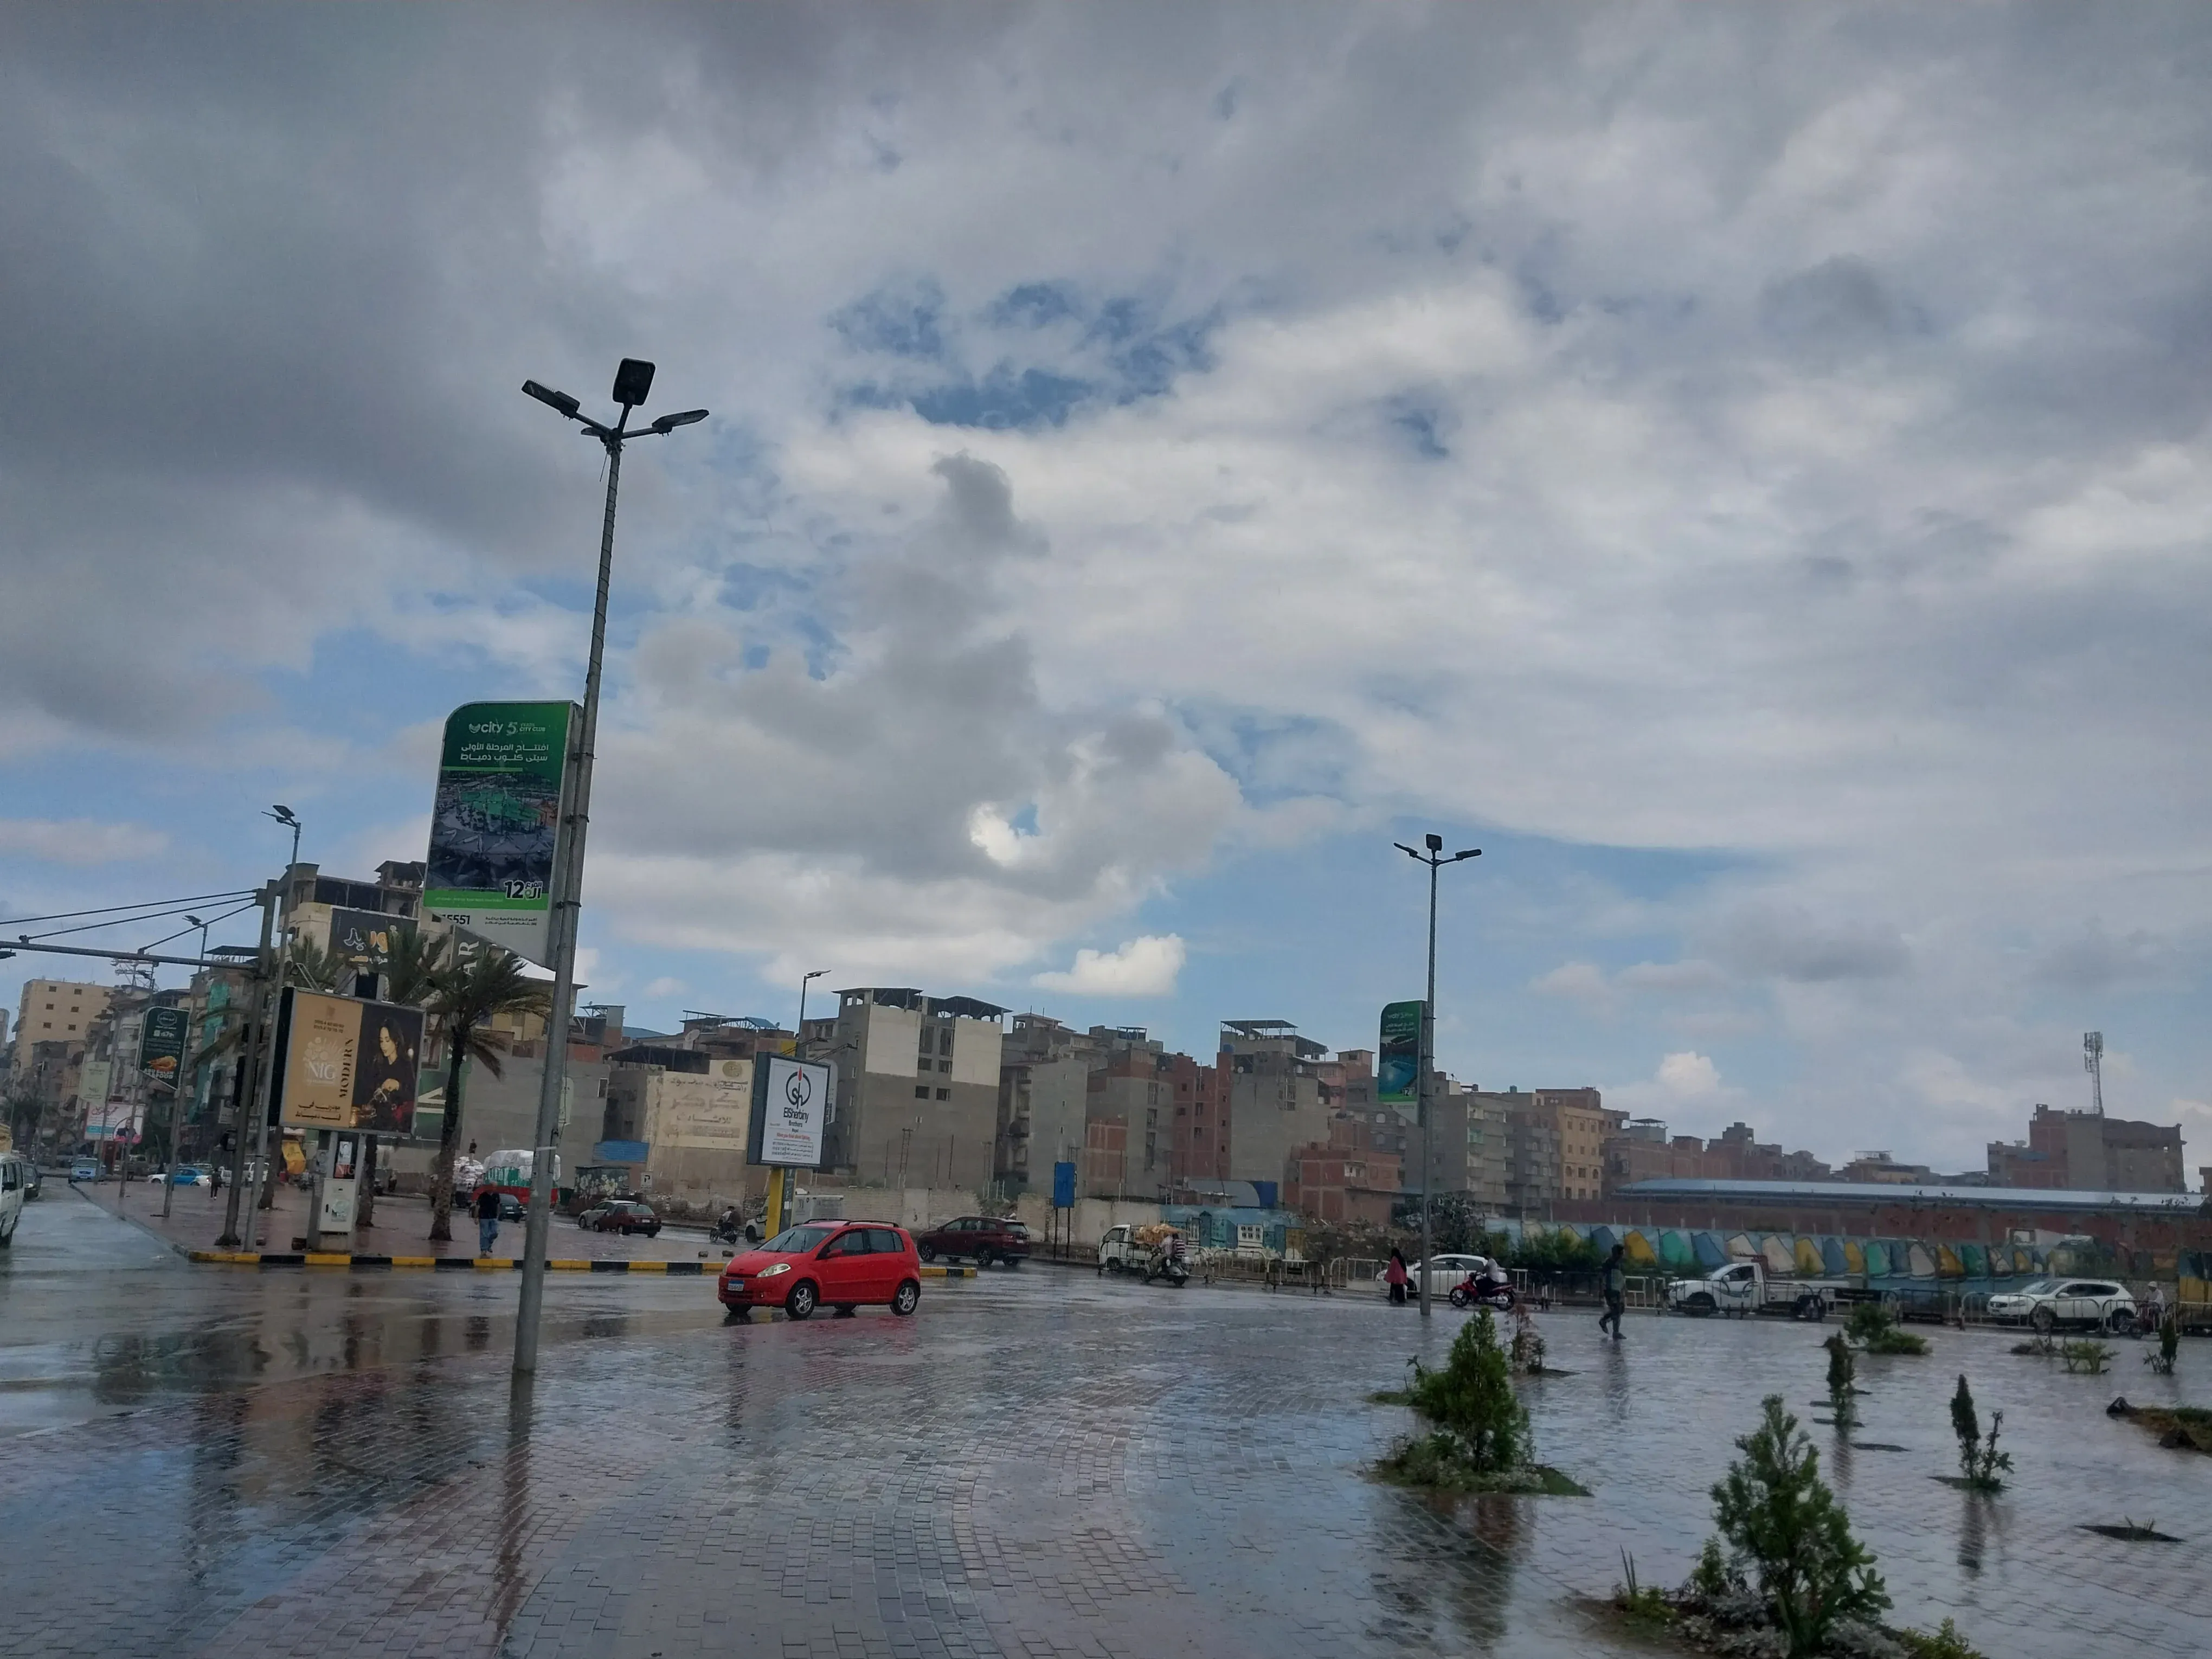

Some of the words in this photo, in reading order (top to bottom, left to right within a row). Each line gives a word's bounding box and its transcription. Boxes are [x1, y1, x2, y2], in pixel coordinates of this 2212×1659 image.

[486, 743, 513, 751] المرحلة
[460, 753, 492, 762] دمياط
[494, 754, 523, 762] كلوب
[441, 914, 470, 925] 5551
